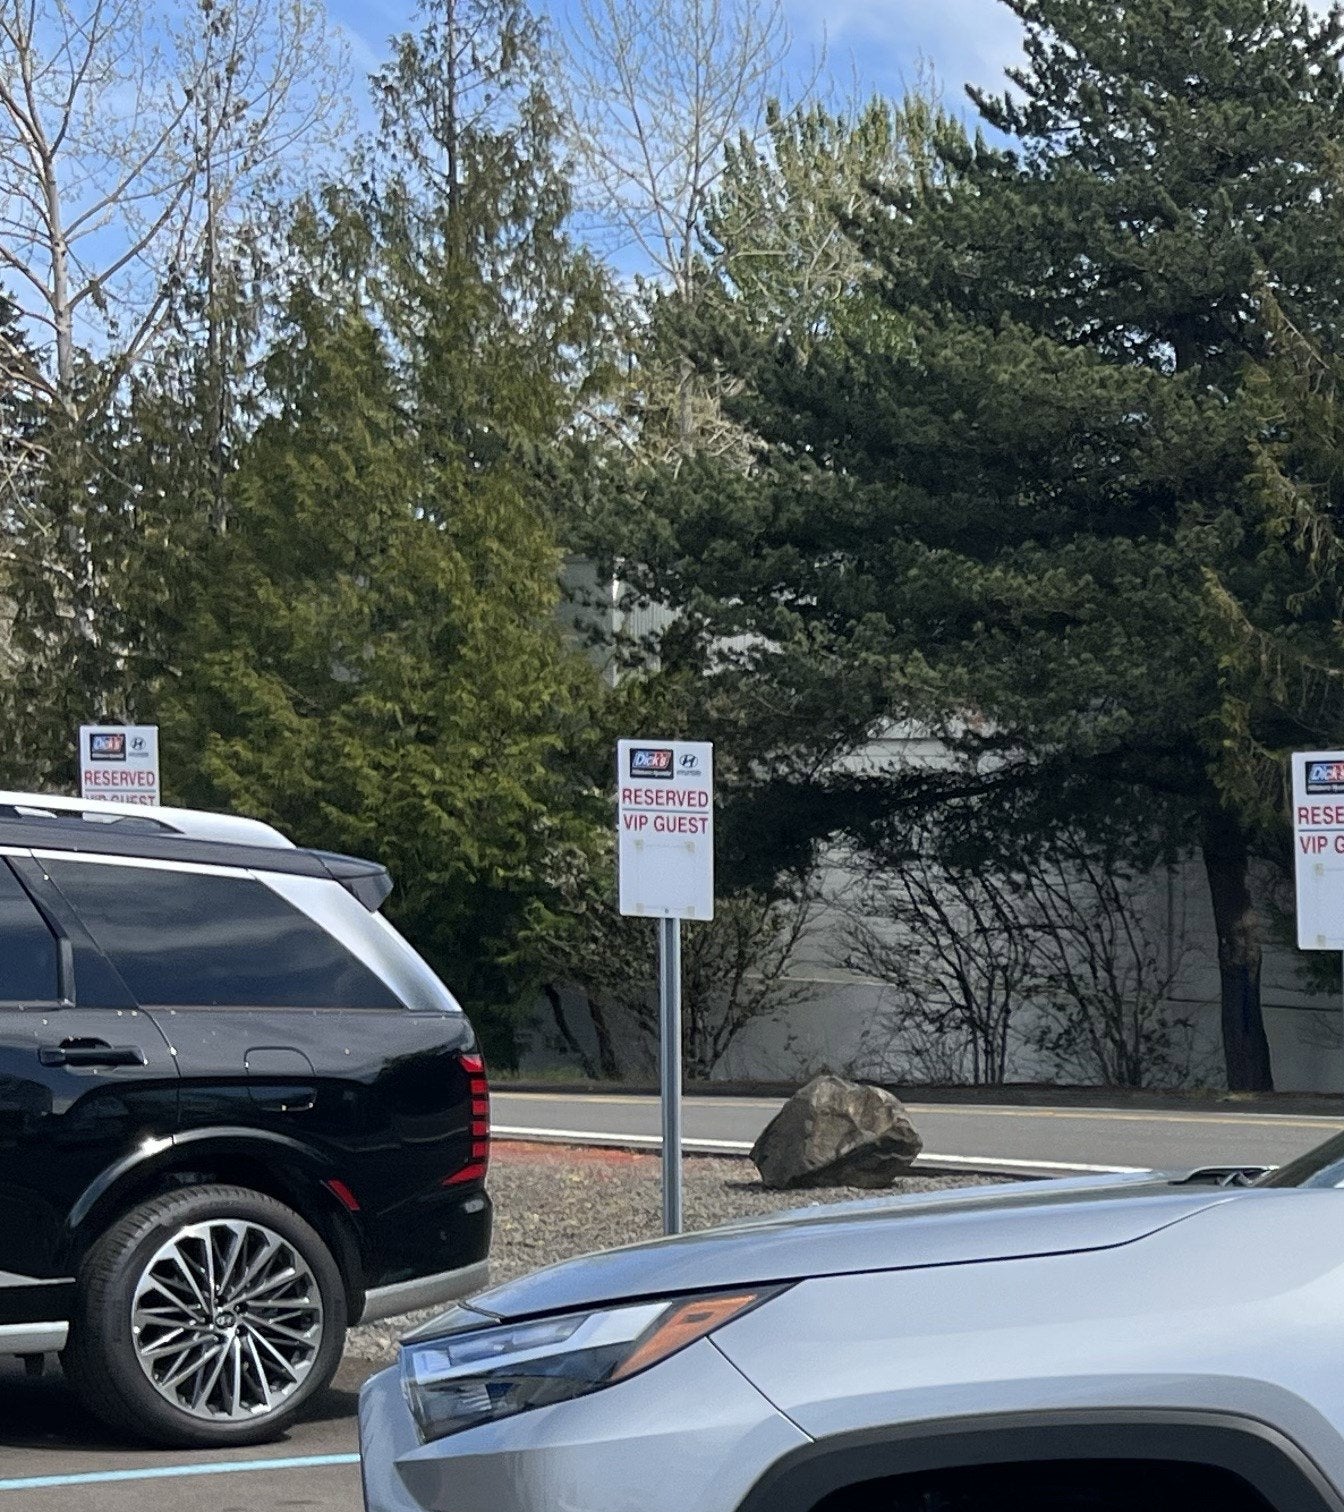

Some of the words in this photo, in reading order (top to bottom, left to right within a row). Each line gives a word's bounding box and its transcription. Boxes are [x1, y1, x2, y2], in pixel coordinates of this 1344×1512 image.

[84, 770, 155, 786] RESERVED
[622, 788, 709, 808] RESERVED
[623, 813, 649, 831] VIP
[653, 815, 709, 834] GUEST
[1299, 835, 1328, 854] VIP
